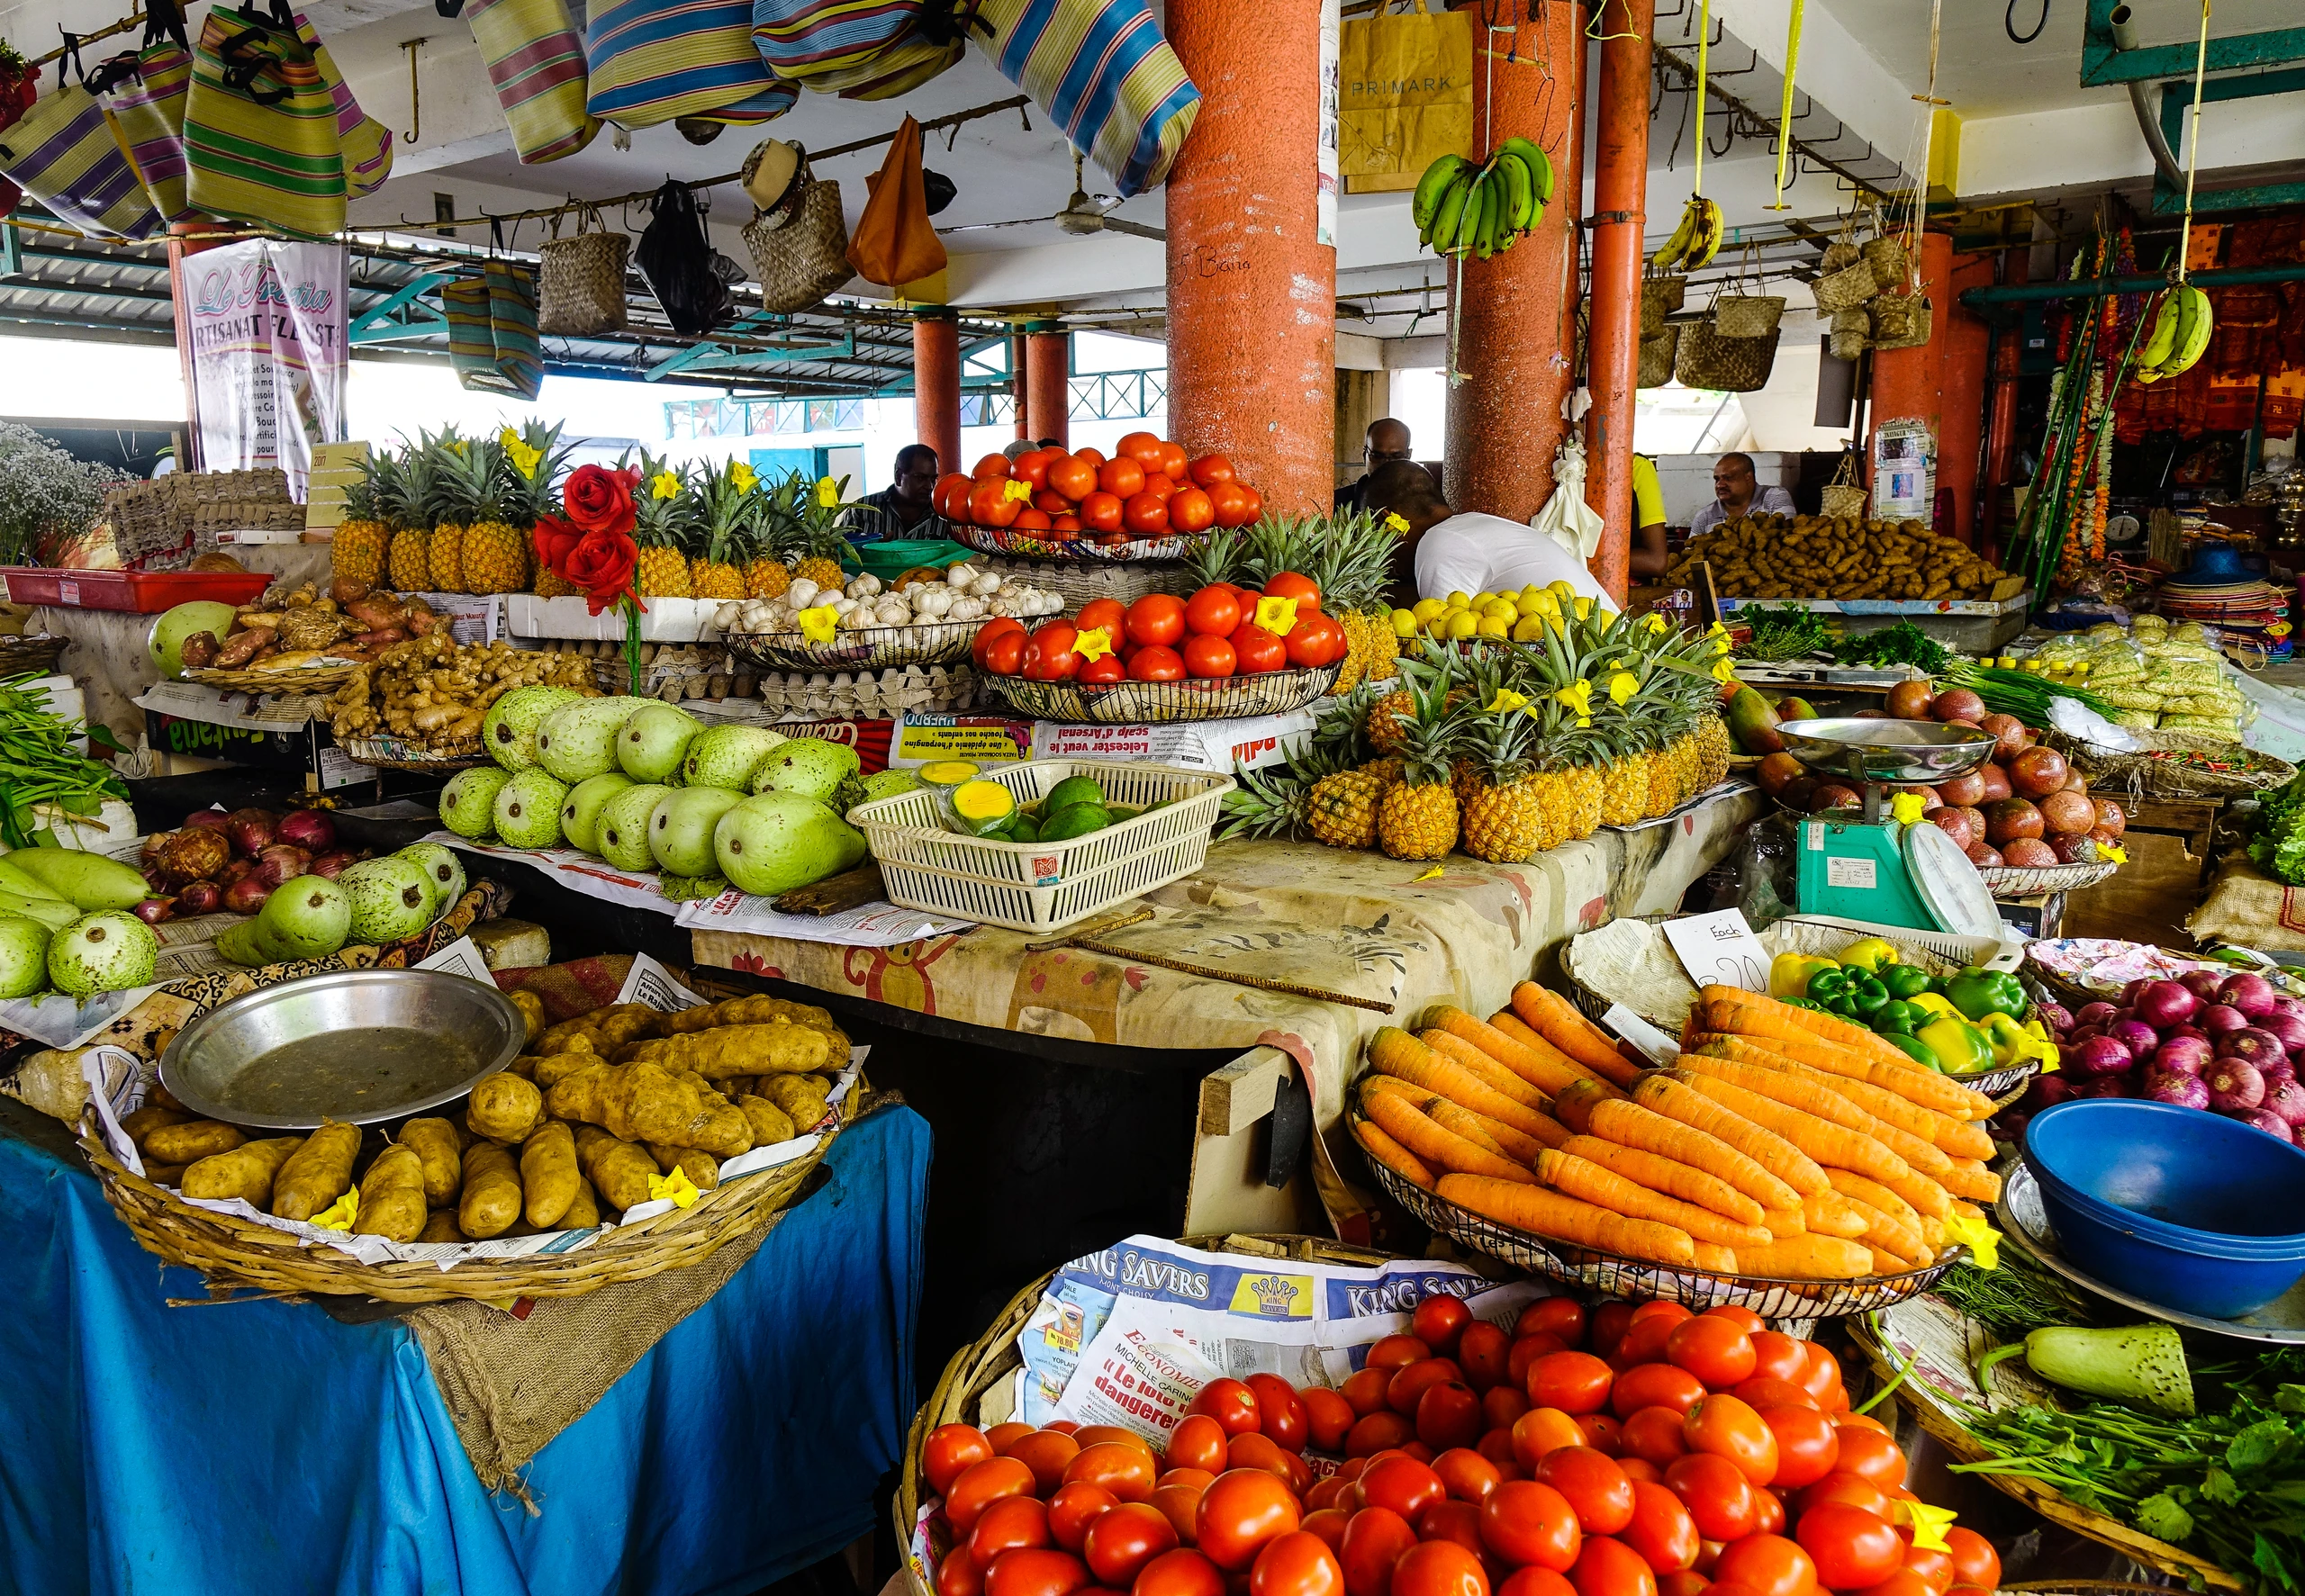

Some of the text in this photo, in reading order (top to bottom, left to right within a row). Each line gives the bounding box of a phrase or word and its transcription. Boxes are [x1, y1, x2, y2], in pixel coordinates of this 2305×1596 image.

[1351, 77, 1451, 96] PRIMARK
[1058, 727, 1149, 739] scalp d'Arsenal
[904, 740, 953, 749] d'herpangine
[955, 741, 986, 750] épidémie
[1049, 743, 1149, 754] Leicester veut le
[1710, 924, 1741, 938] Each
[637, 988, 649, 999] Le
[640, 981, 663, 997] Affaire
[1121, 1250, 1209, 1300] SAVERS
[1266, 1296, 1282, 1304] KING
[1346, 1279, 1420, 1318] KING
[1262, 1304, 1287, 1312] SAVERS
[1056, 1336, 1073, 1348] 78.80
[1114, 1343, 1158, 1385] MICHELLE
[1114, 1363, 1135, 1390] Le
